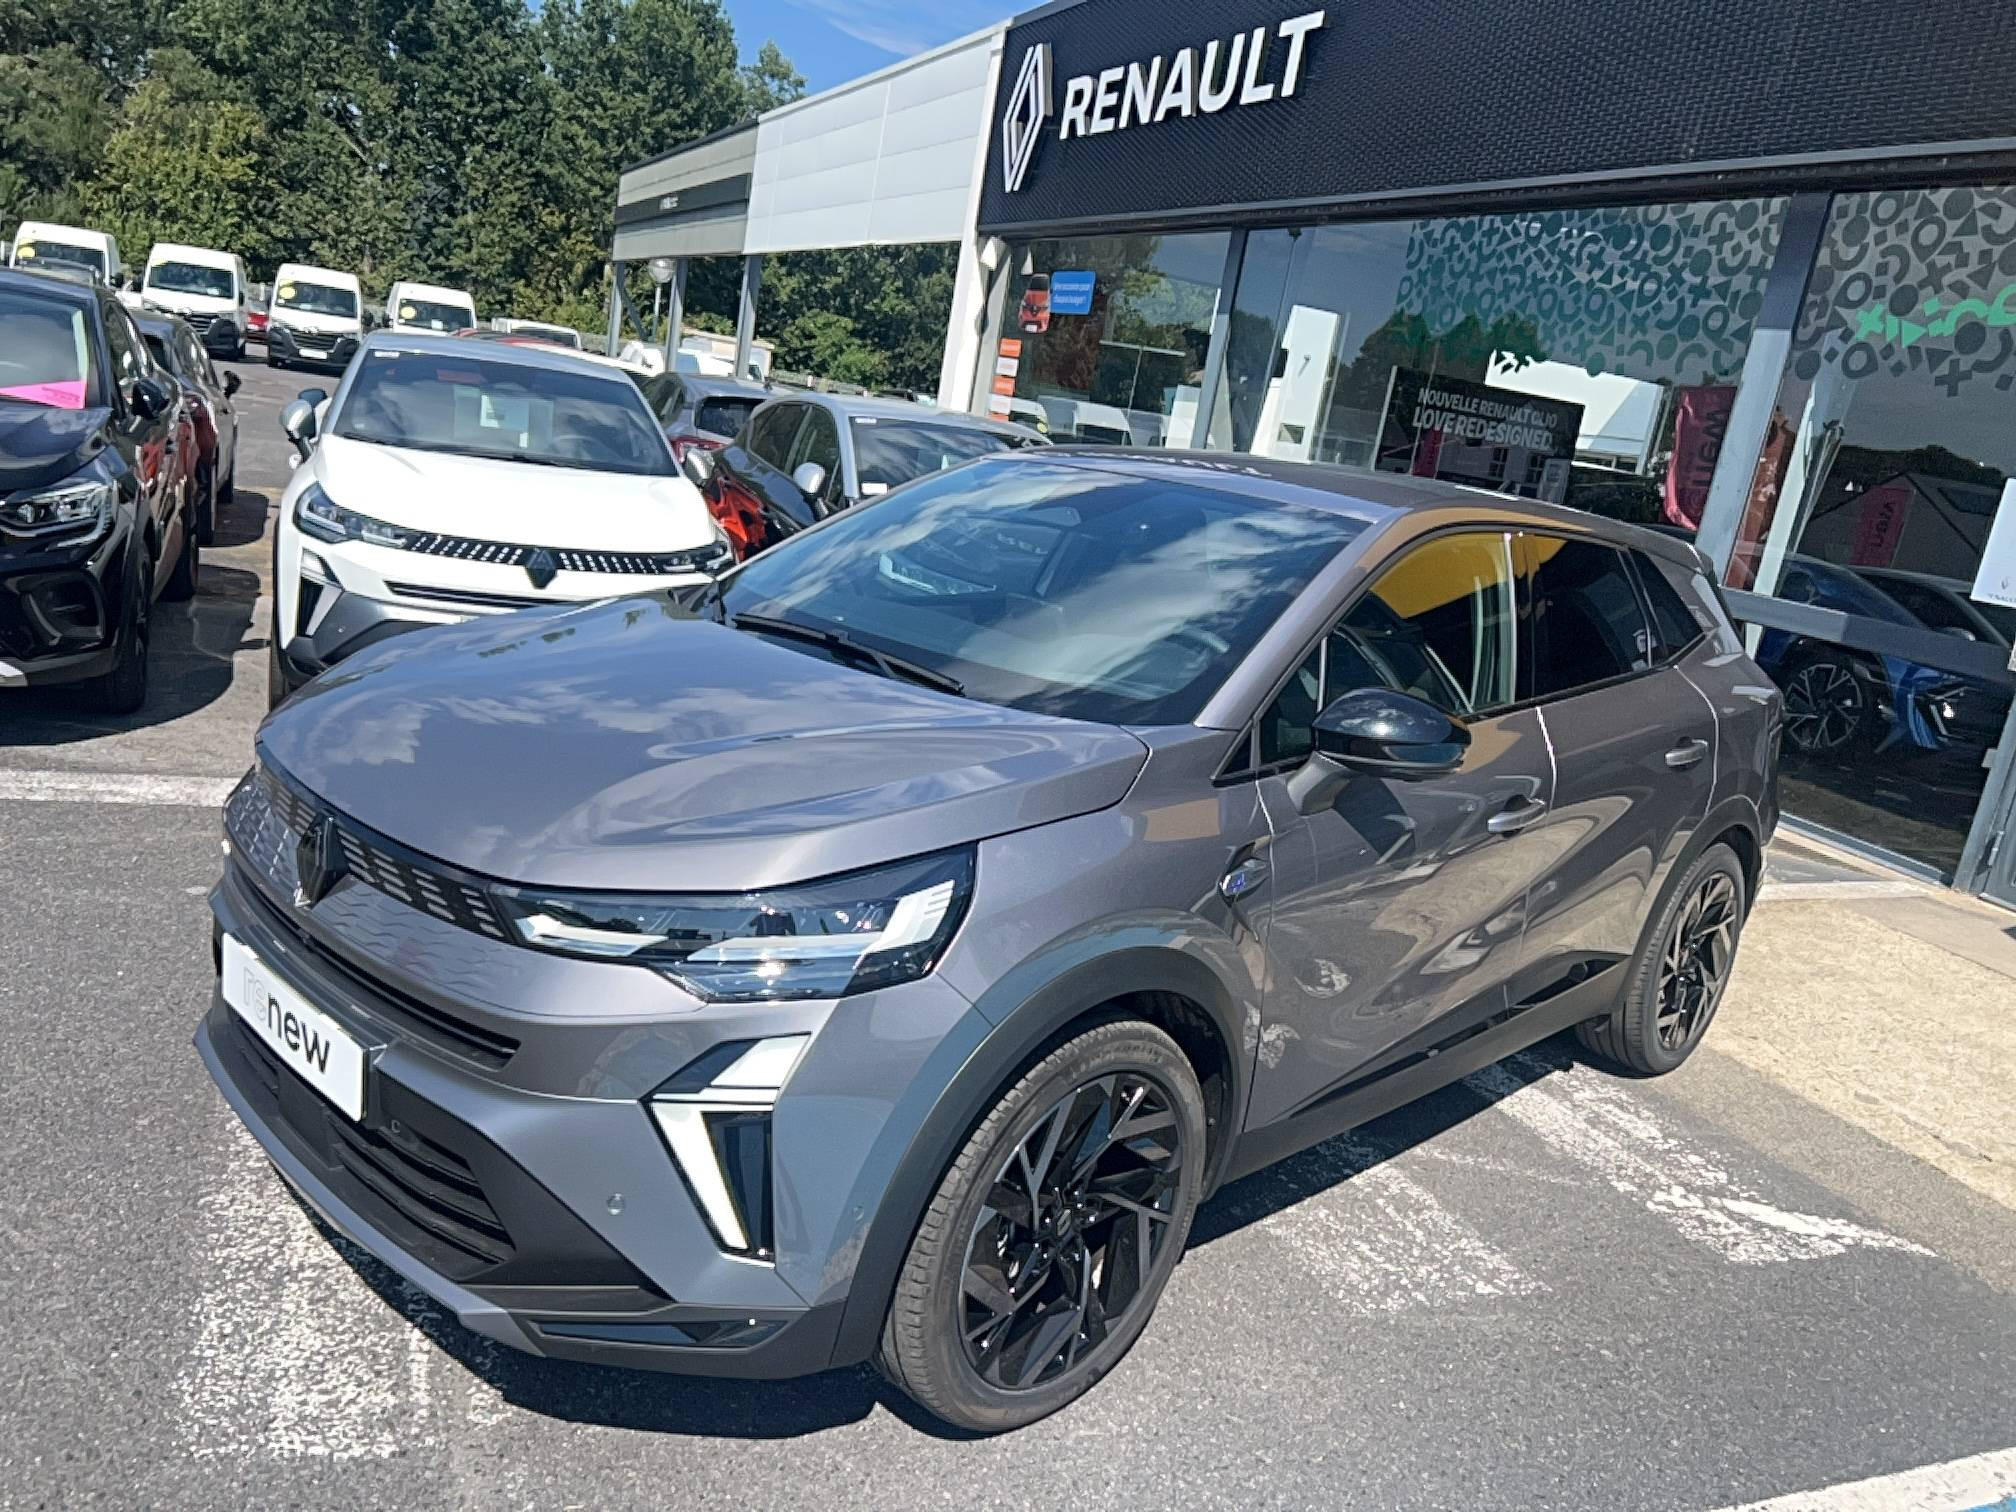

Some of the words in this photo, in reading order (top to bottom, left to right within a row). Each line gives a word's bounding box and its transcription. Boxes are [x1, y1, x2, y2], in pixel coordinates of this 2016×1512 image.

[1059, 10, 1326, 141] RENAULT
[1412, 405, 1456, 433] LOVE
[1417, 387, 1480, 413] NOUVELLE
[1479, 399, 1532, 424] RENAULT
[1530, 409, 1558, 429] CLIO
